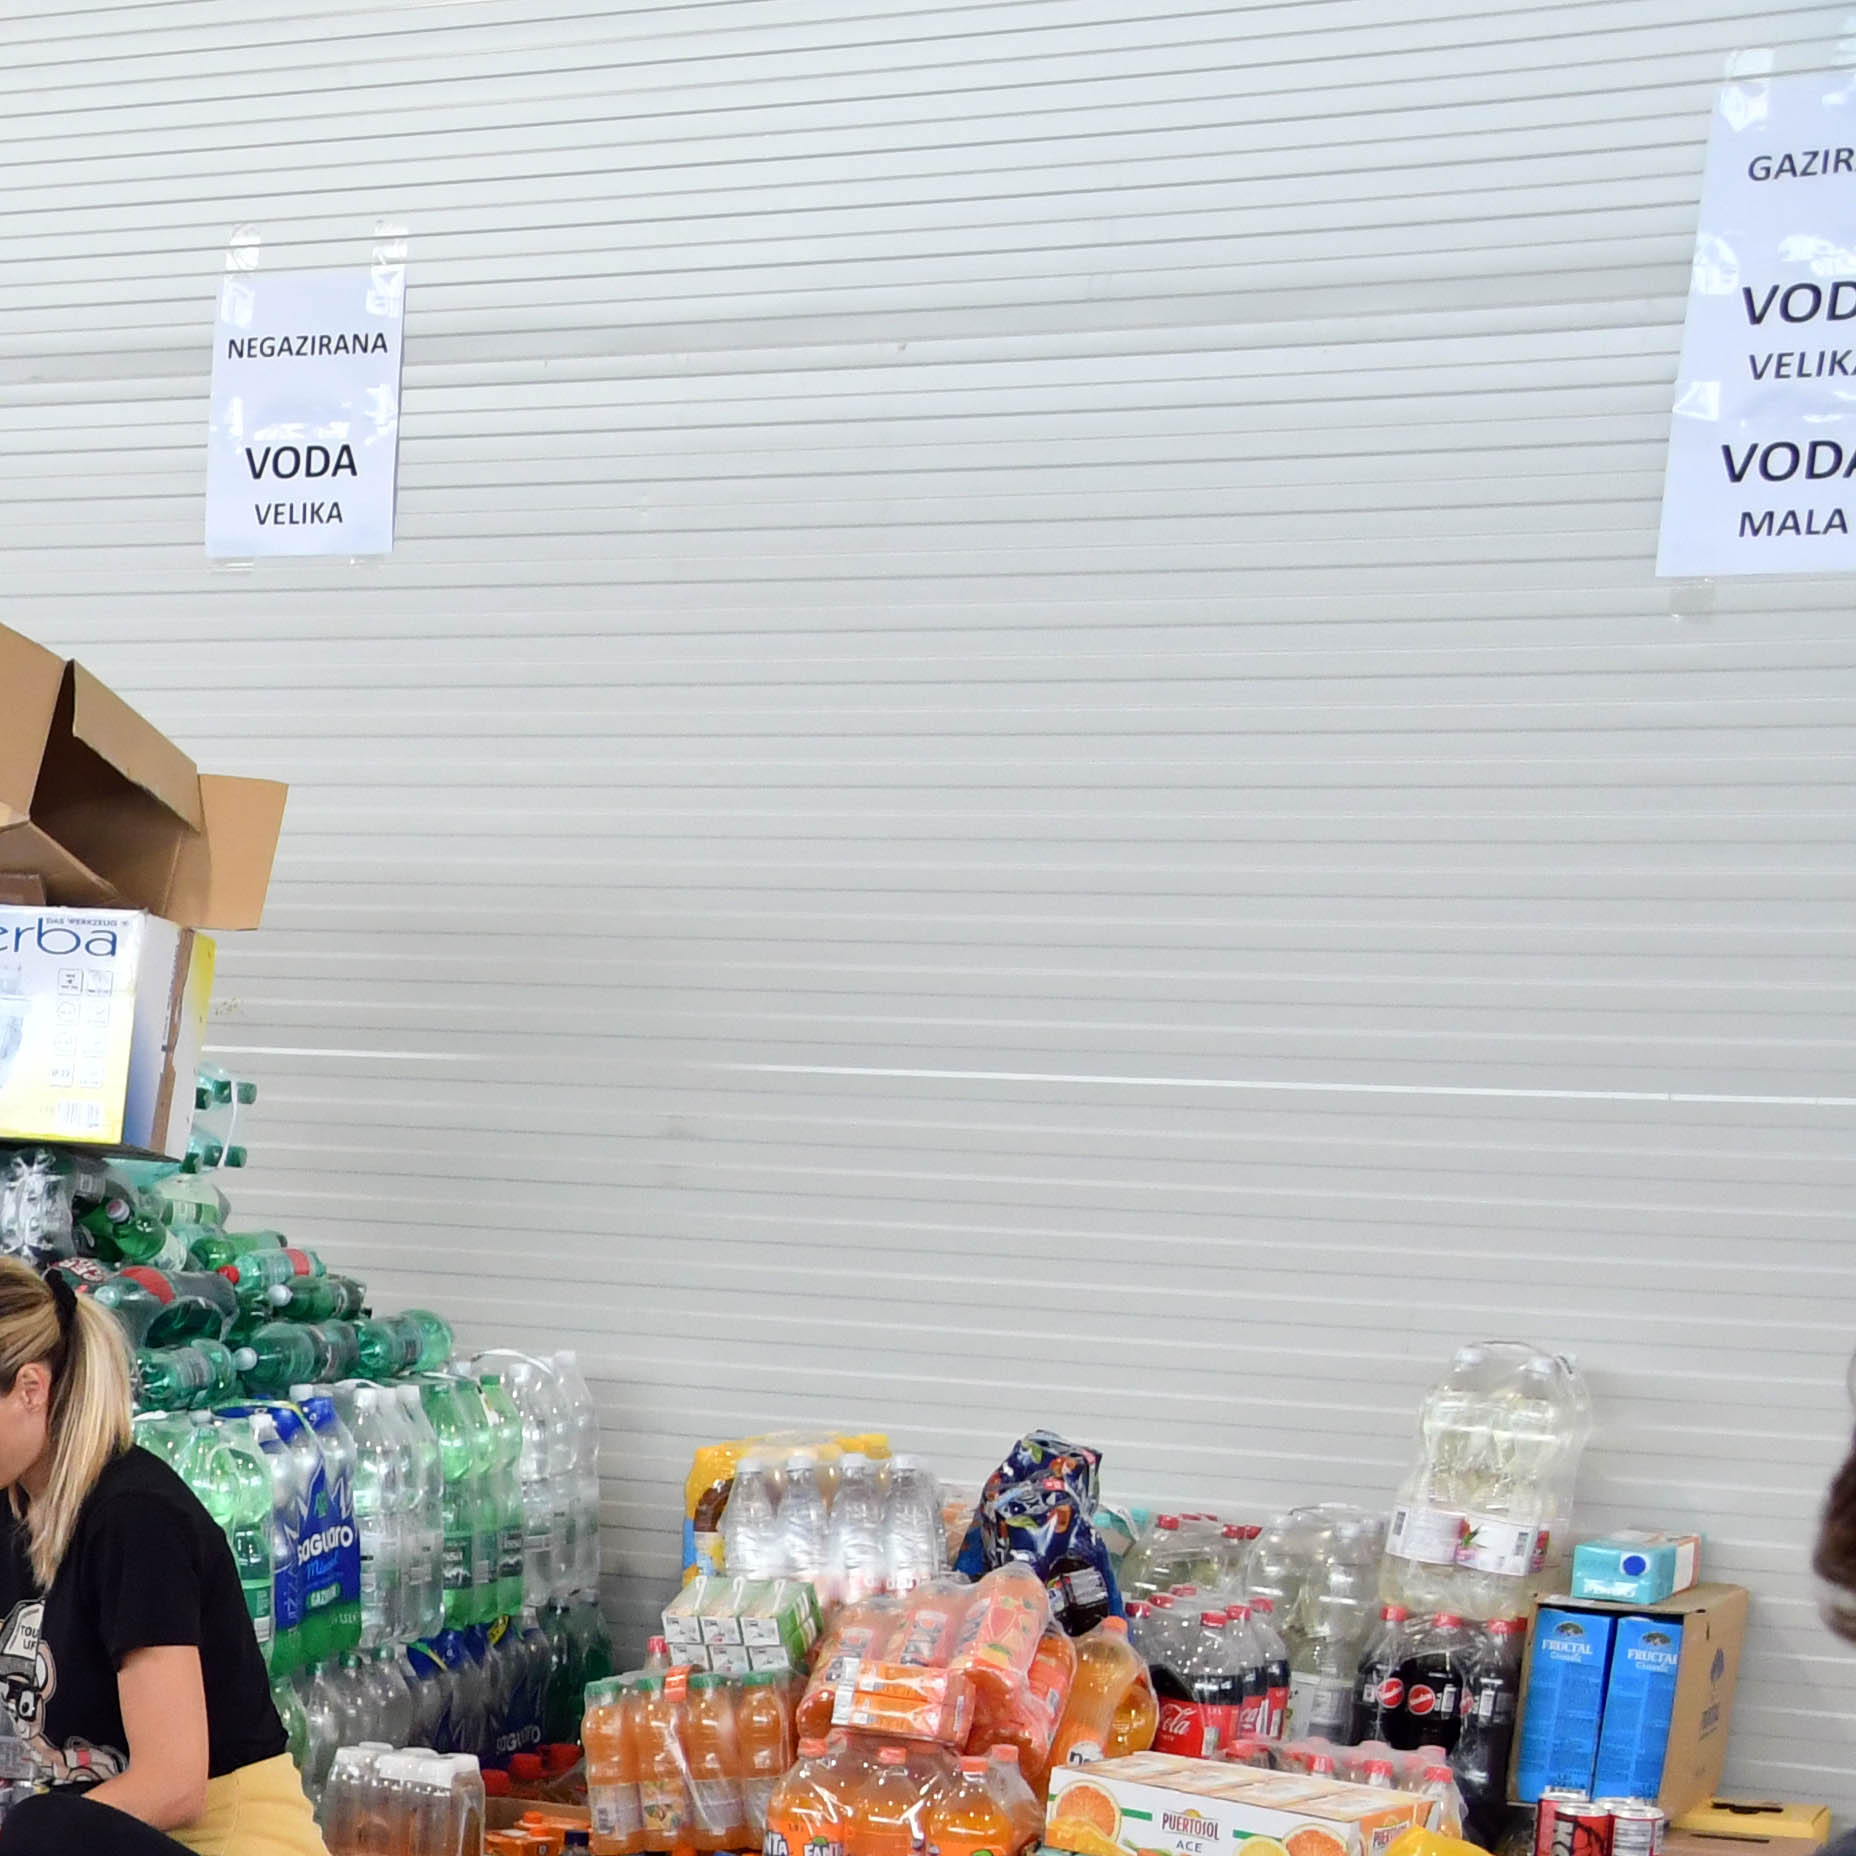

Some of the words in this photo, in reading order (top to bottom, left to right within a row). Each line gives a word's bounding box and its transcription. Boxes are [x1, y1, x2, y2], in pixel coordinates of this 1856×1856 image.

[228, 332, 389, 359] NEGAZIRANA
[1748, 349, 1856, 381] VELIK
[245, 443, 358, 480] VODA
[254, 501, 344, 526] VELIKA
[1738, 507, 1849, 538] MALA
[1540, 1639, 1594, 1656] FRUCTAL
[1161, 1810, 1222, 1842] PUERTOSOL
[1176, 1838, 1204, 1854] ACE
